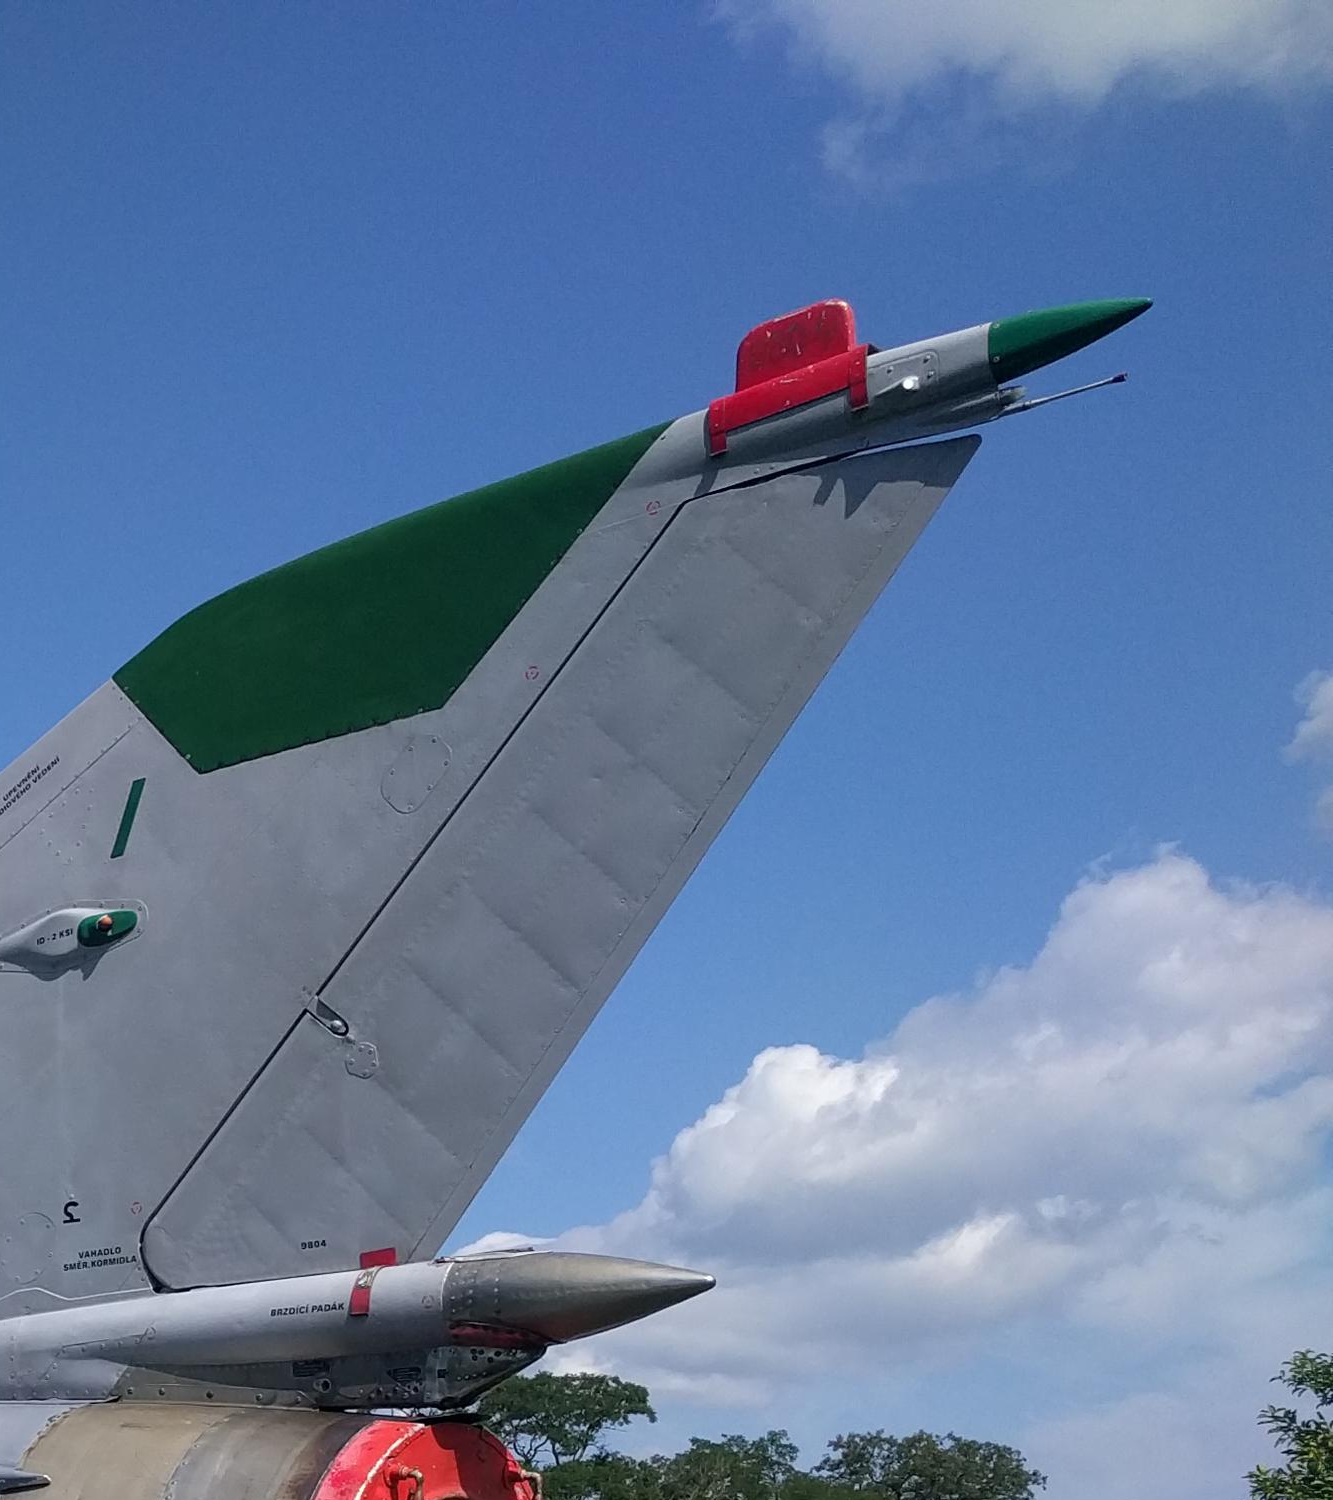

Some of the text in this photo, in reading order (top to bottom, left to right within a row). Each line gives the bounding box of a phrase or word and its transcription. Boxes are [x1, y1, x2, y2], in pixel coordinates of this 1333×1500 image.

[300, 1239, 327, 1250] 9804
[78, 1246, 122, 1259] VAHADLO
[311, 1301, 345, 1314] PADÁK
